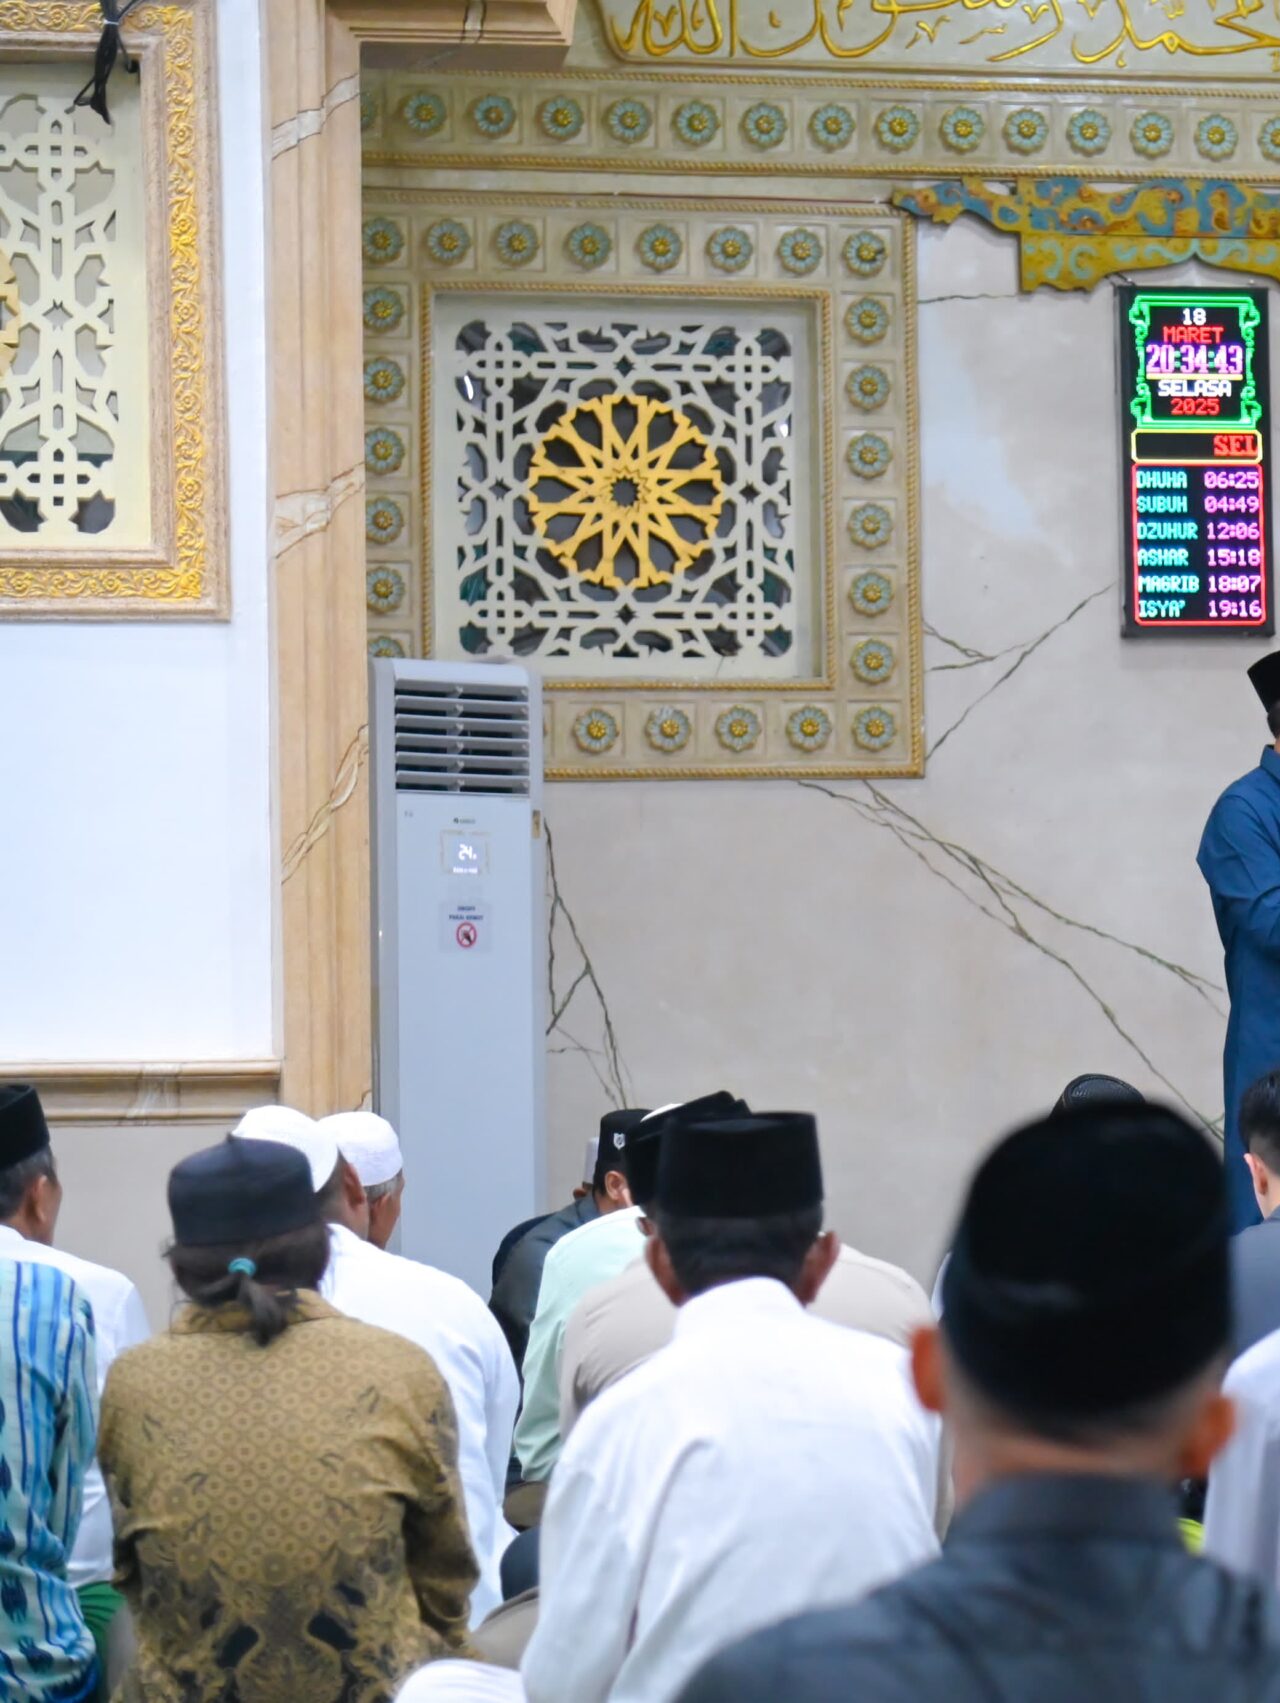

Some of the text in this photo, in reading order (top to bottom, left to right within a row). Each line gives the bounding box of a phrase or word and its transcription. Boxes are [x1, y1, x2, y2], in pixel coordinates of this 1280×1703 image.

[1182, 308, 1206, 325] 18
[1163, 326, 1224, 344] MARET
[1146, 344, 1243, 374] 20:34:43
[1158, 379, 1232, 397] SELASA
[1170, 398, 1220, 415] 2025
[1136, 471, 1259, 489] DHUHA 06:25
[1136, 496, 1259, 513] SUBUH 04:49
[1136, 522, 1259, 540] DZUHUR 12:06
[1137, 548, 1260, 566] ASHAR 15:18
[1137, 575, 1261, 593] MAGRIB 18:07
[1209, 600, 1262, 618] 19:16
